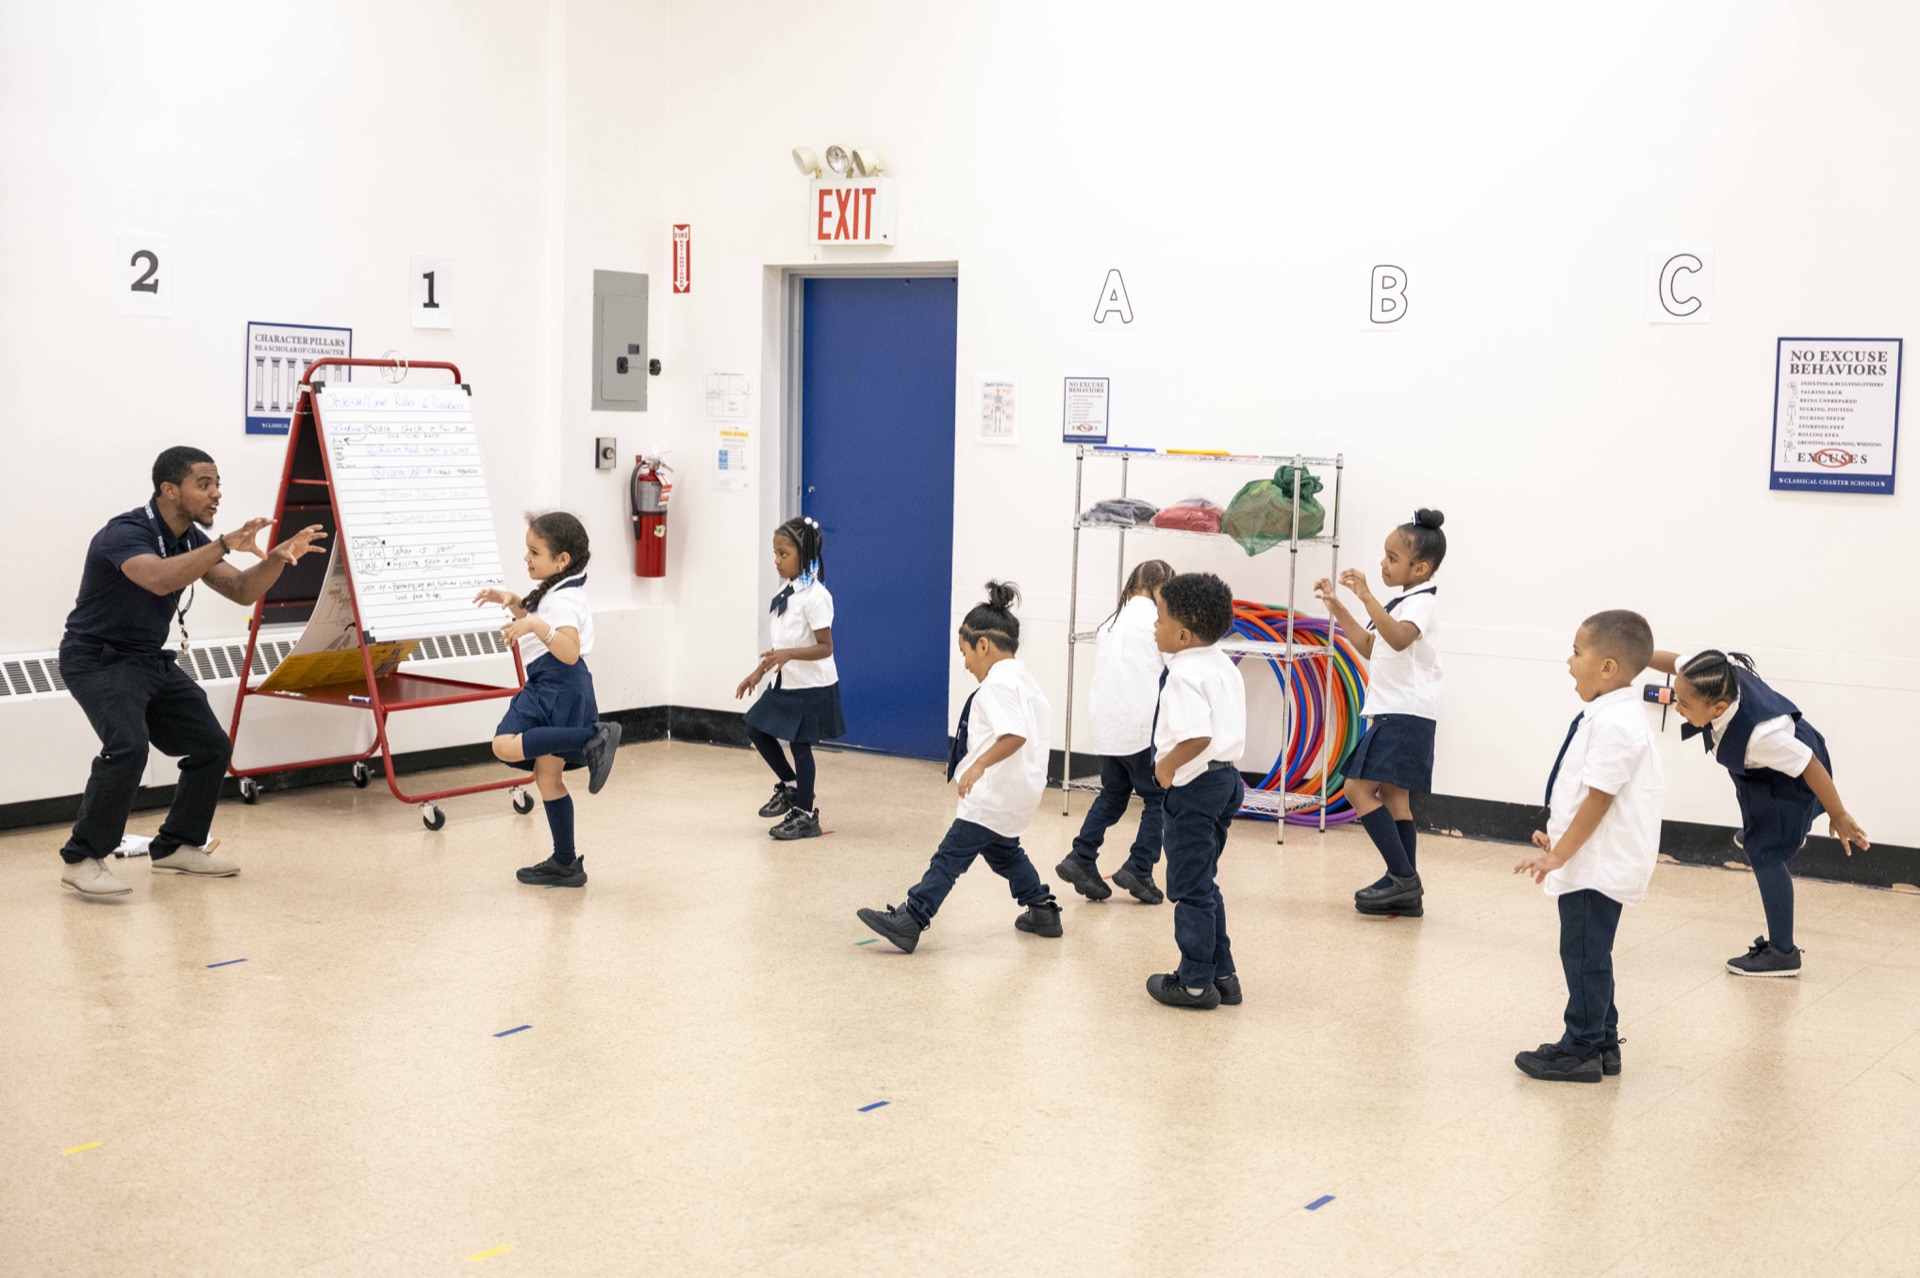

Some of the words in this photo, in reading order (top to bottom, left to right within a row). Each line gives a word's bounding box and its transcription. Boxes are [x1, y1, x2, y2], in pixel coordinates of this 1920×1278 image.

[817, 188, 876, 240] EXIT
[130, 249, 159, 294] 2
[1659, 253, 1702, 316] C
[422, 271, 440, 309] 1
[1093, 268, 1134, 324] A
[1370, 264, 1408, 324] B
[254, 333, 309, 345] CHARACTER
[309, 337, 346, 347] PILLARS
[268, 345, 297, 353] SCHOLAR
[305, 347, 345, 356] CHARACTER
[1789, 363, 1887, 376] BEHAVIORS
[1790, 350, 1815, 362] NO
[1820, 350, 1888, 363] EXCUSE
[1797, 452, 1868, 464] EXCUSES
[1783, 477, 1818, 485] CLASSICAL
[1818, 478, 1850, 486] CHARTER
[1850, 479, 1881, 487] SCHOOLS
